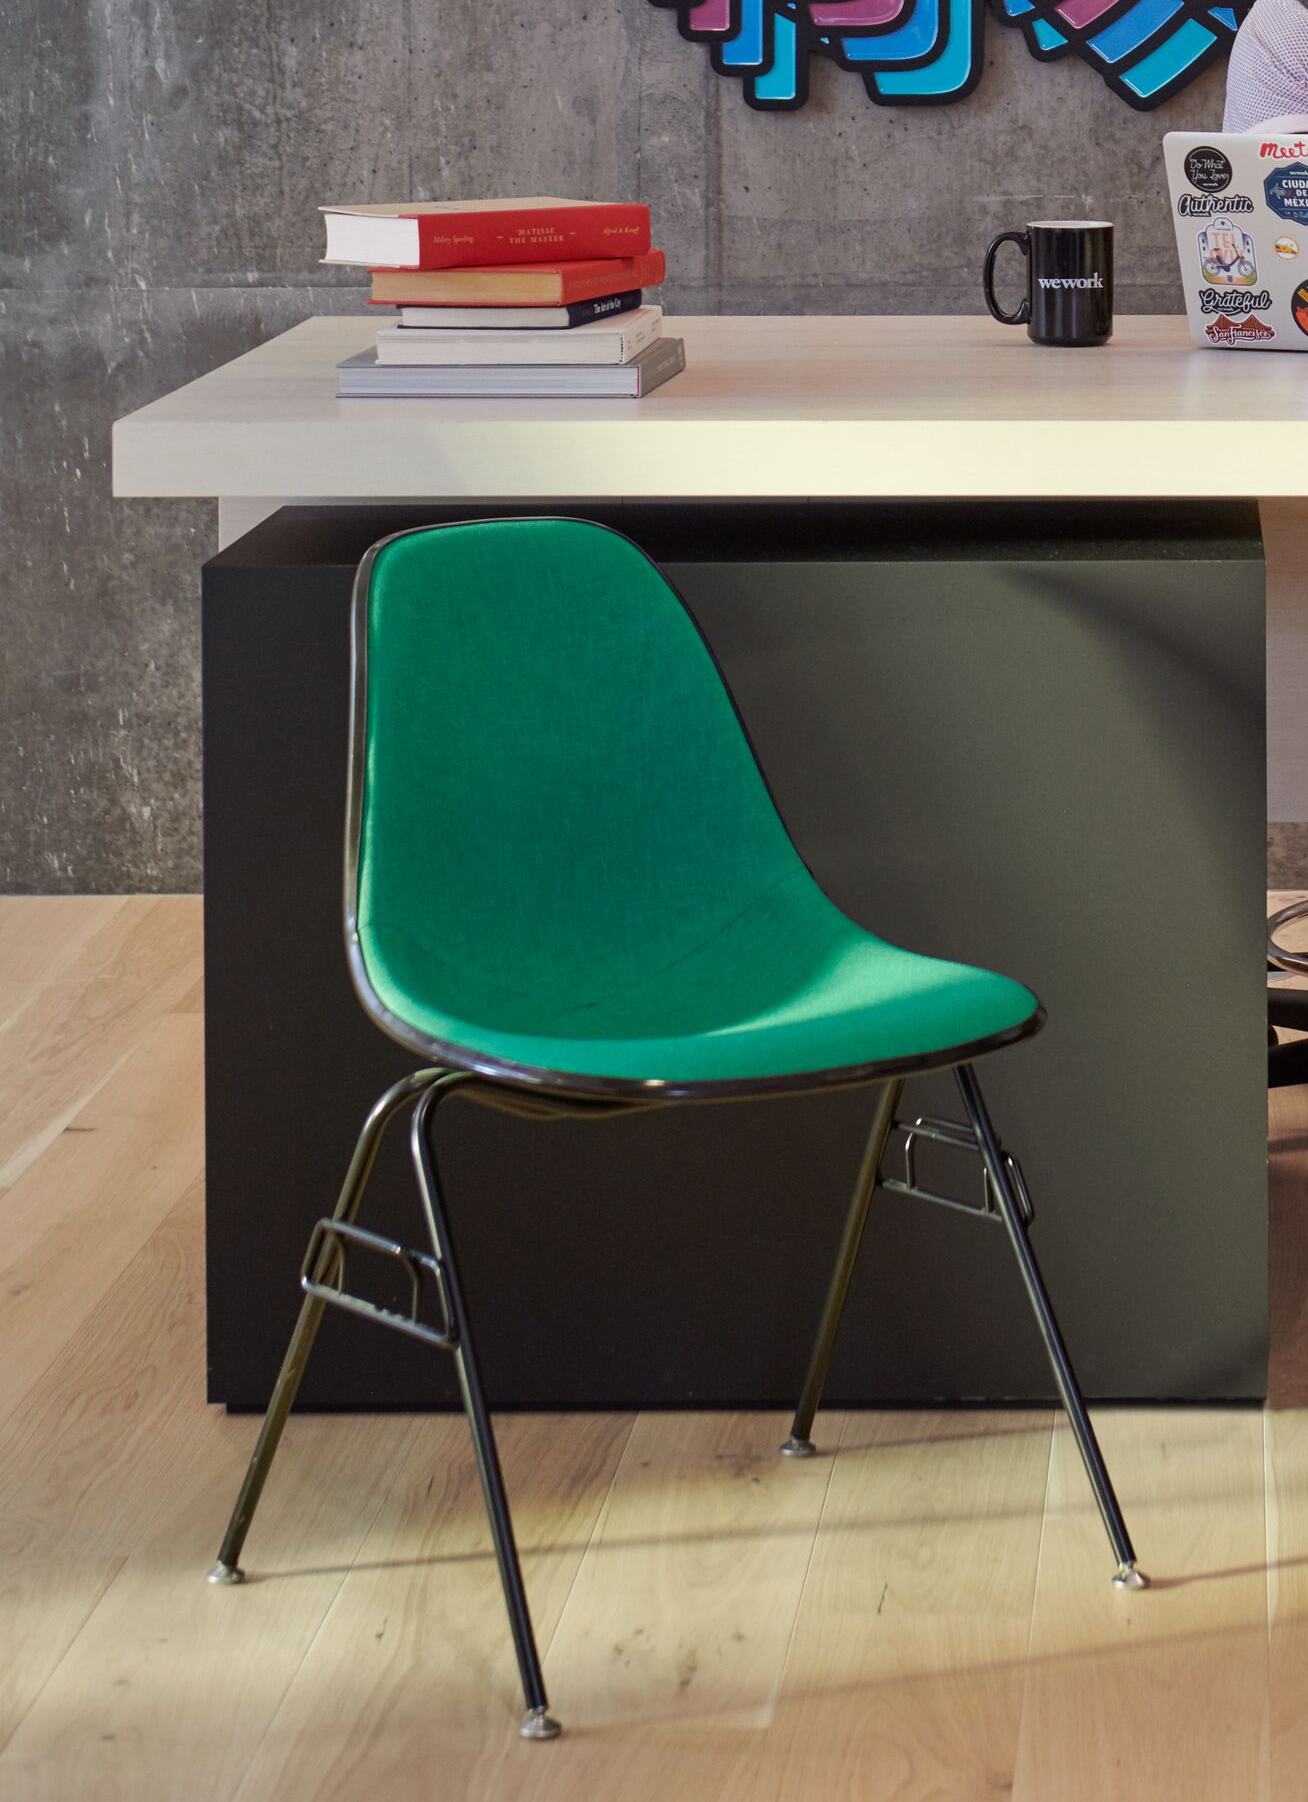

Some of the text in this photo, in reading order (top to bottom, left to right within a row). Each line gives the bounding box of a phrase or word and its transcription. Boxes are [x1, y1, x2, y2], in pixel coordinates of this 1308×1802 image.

[1296, 189, 1308, 197] DE
[518, 227, 555, 236] MATISSE
[510, 234, 564, 244] THE MASTER
[1038, 271, 1104, 289] wework
[1200, 289, 1270, 315] Grateful
